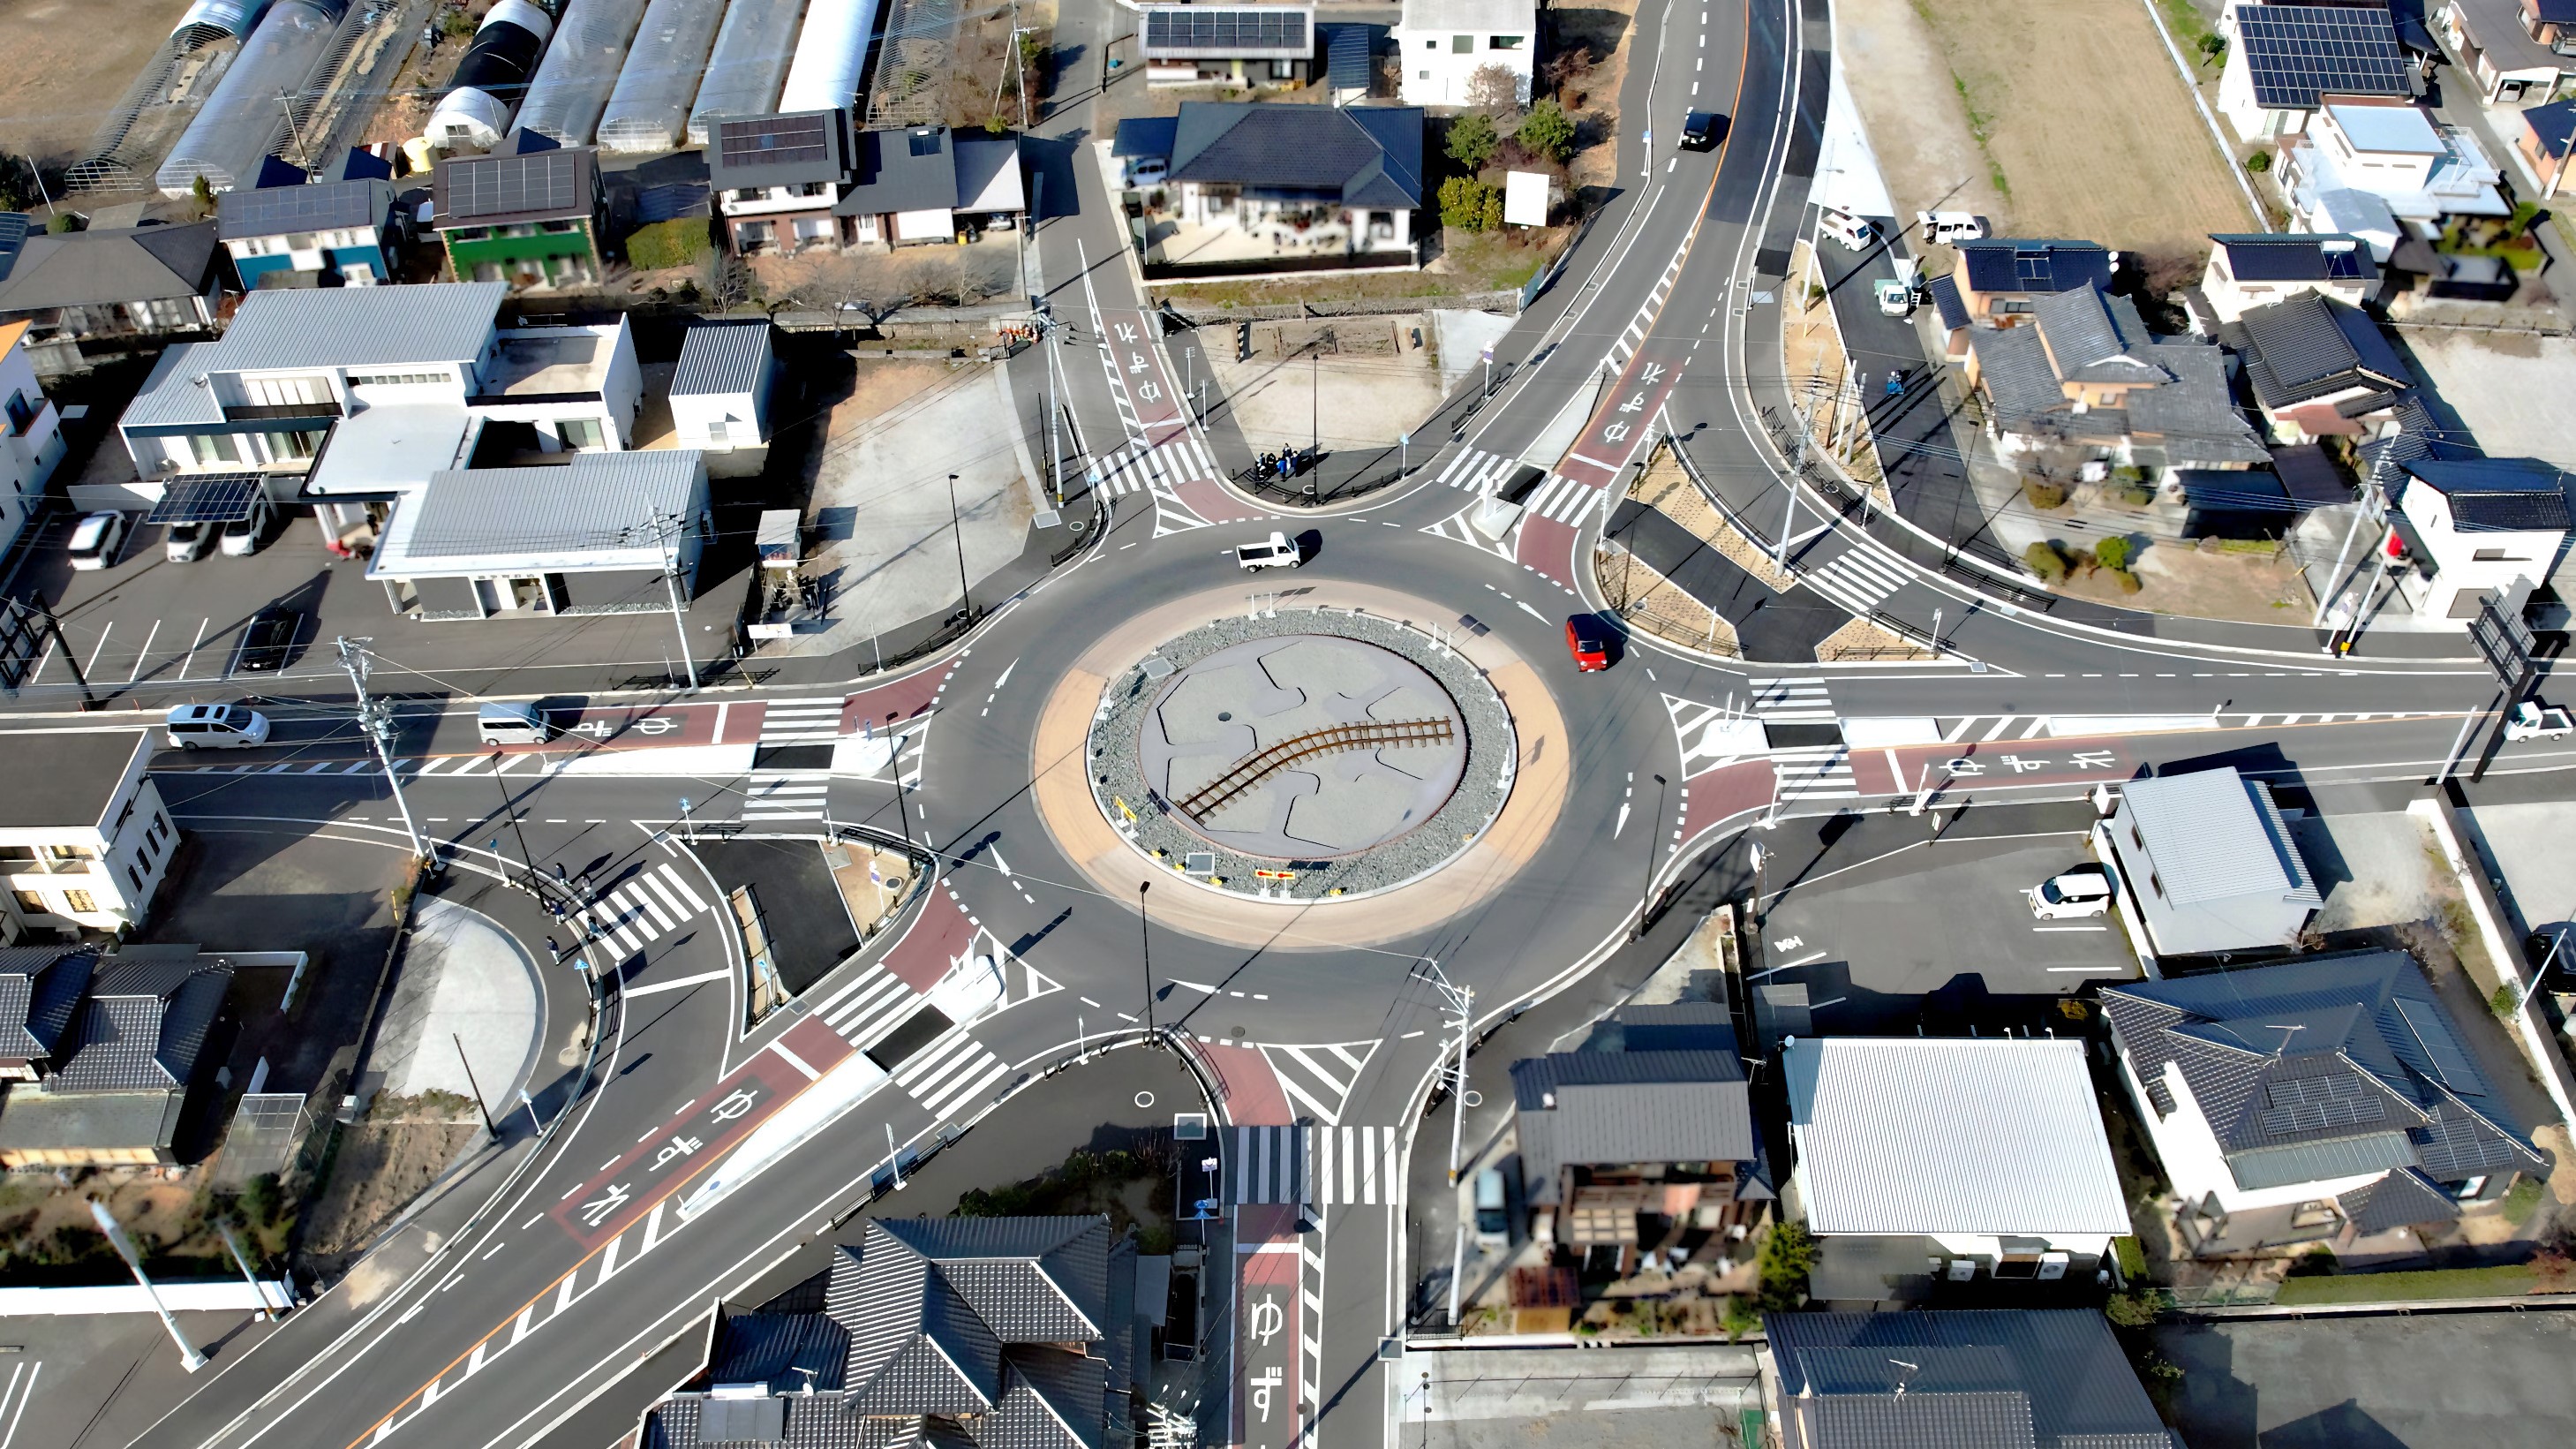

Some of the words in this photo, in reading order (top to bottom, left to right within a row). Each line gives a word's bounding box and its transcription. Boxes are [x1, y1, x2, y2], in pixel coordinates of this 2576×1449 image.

[1114, 322, 1162, 404] ゆずれ
[1604, 362, 1666, 442] ゆずれ
[566, 717, 678, 737] ゆず
[1939, 750, 2116, 777] ゆずれ
[581, 1089, 758, 1226] ゆずれ
[1250, 1294, 1284, 1449] ゆず
